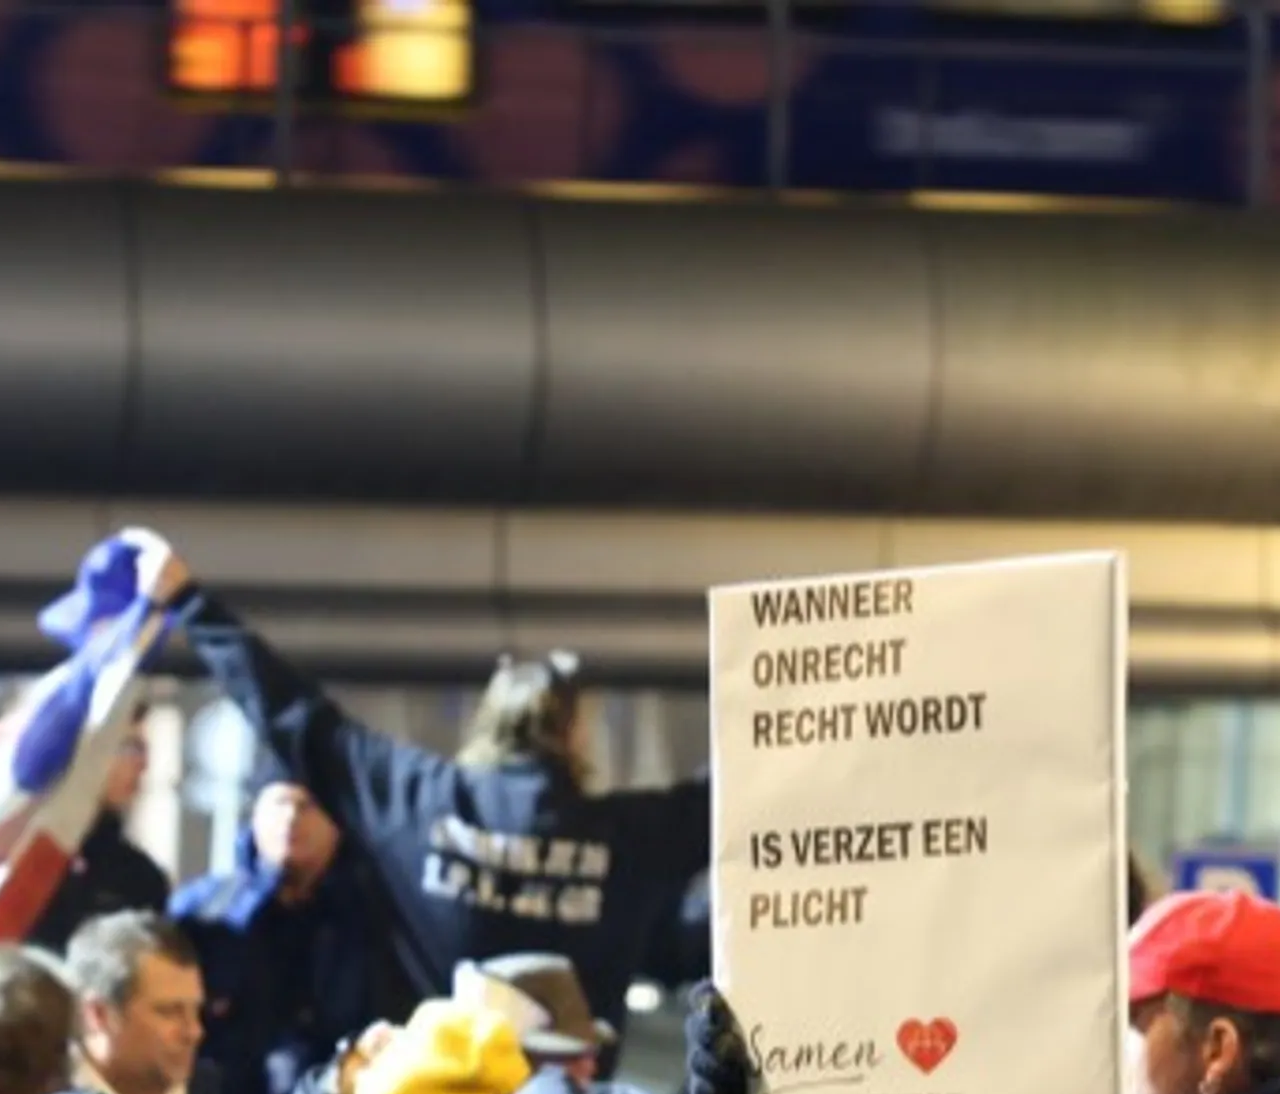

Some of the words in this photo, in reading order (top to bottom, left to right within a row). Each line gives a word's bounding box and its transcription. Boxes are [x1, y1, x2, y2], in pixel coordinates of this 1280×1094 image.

[751, 578, 913, 628] WANNEER
[753, 639, 907, 688] ONRECHT
[753, 704, 856, 748] RECHT
[866, 692, 986, 738] WORDT
[750, 831, 783, 869] IS
[790, 822, 913, 866] VERZET
[923, 816, 988, 857] EEN
[750, 887, 868, 930] PLICHT
[749, 1022, 883, 1078] Samen
